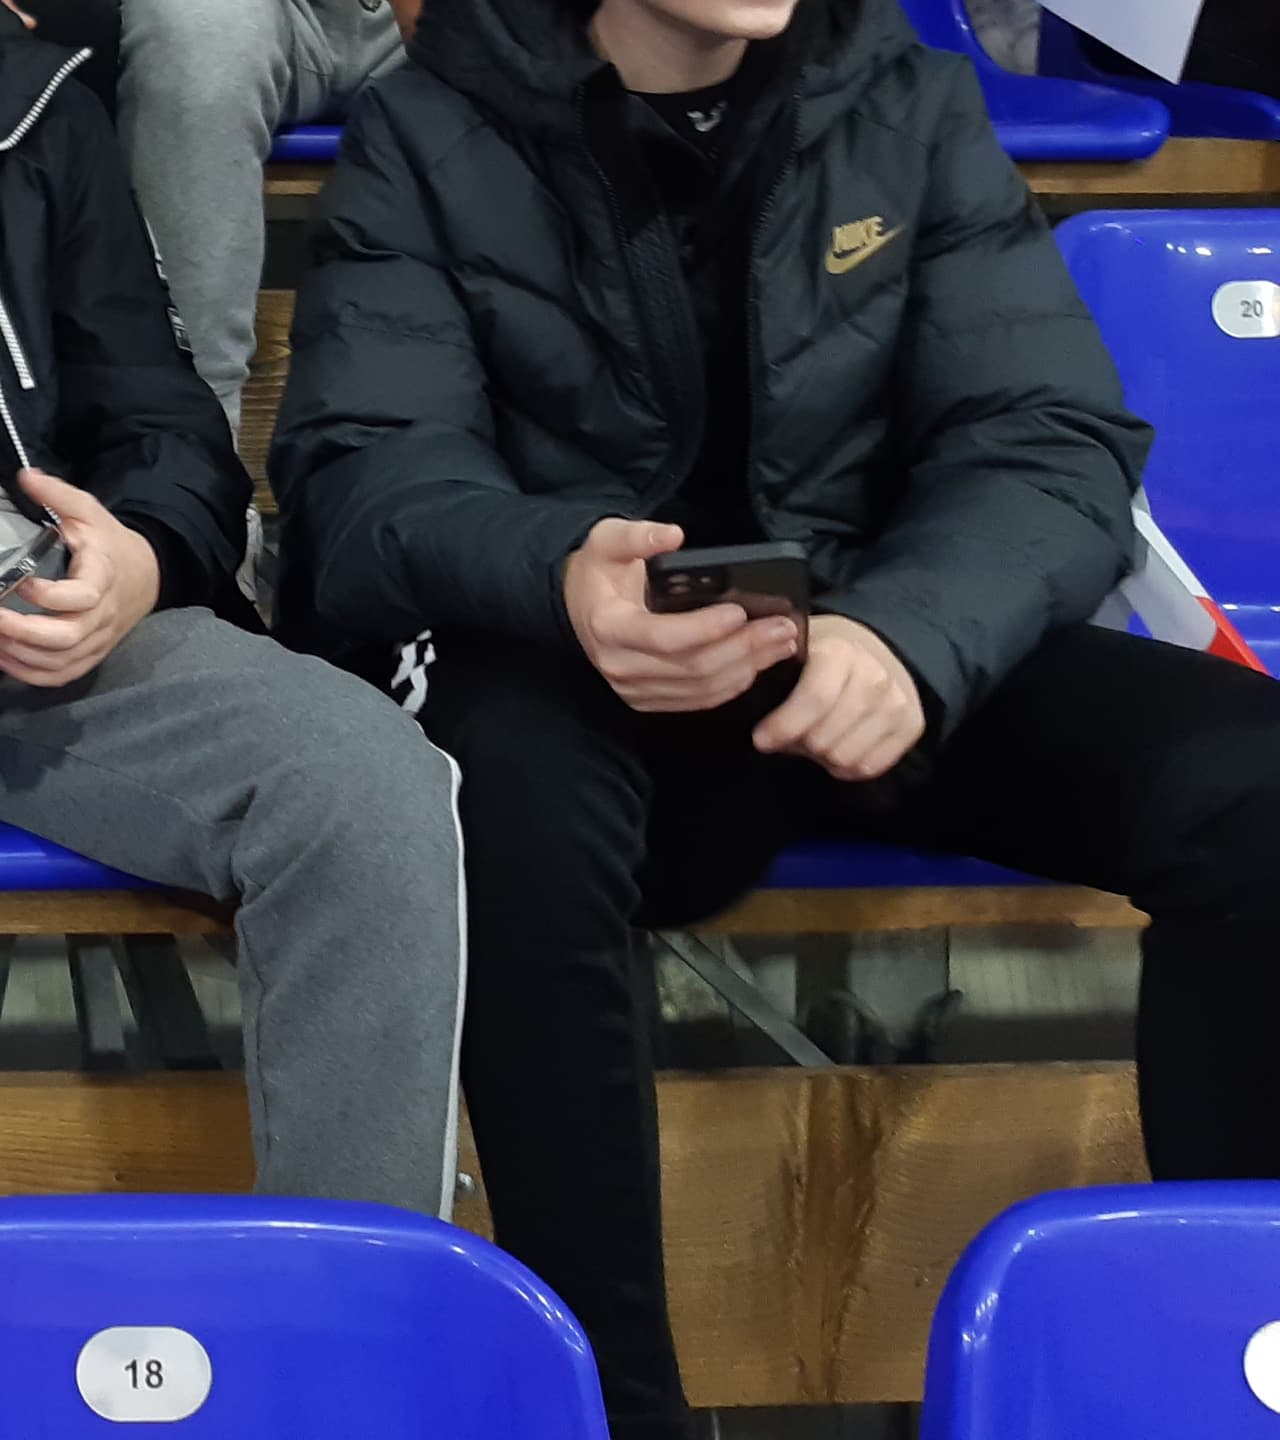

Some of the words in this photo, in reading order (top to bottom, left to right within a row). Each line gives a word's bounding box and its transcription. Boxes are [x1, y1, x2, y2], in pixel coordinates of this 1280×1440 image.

[831, 216, 884, 254] NIKE
[1240, 300, 1264, 318] 20
[124, 1359, 163, 1389] 18
